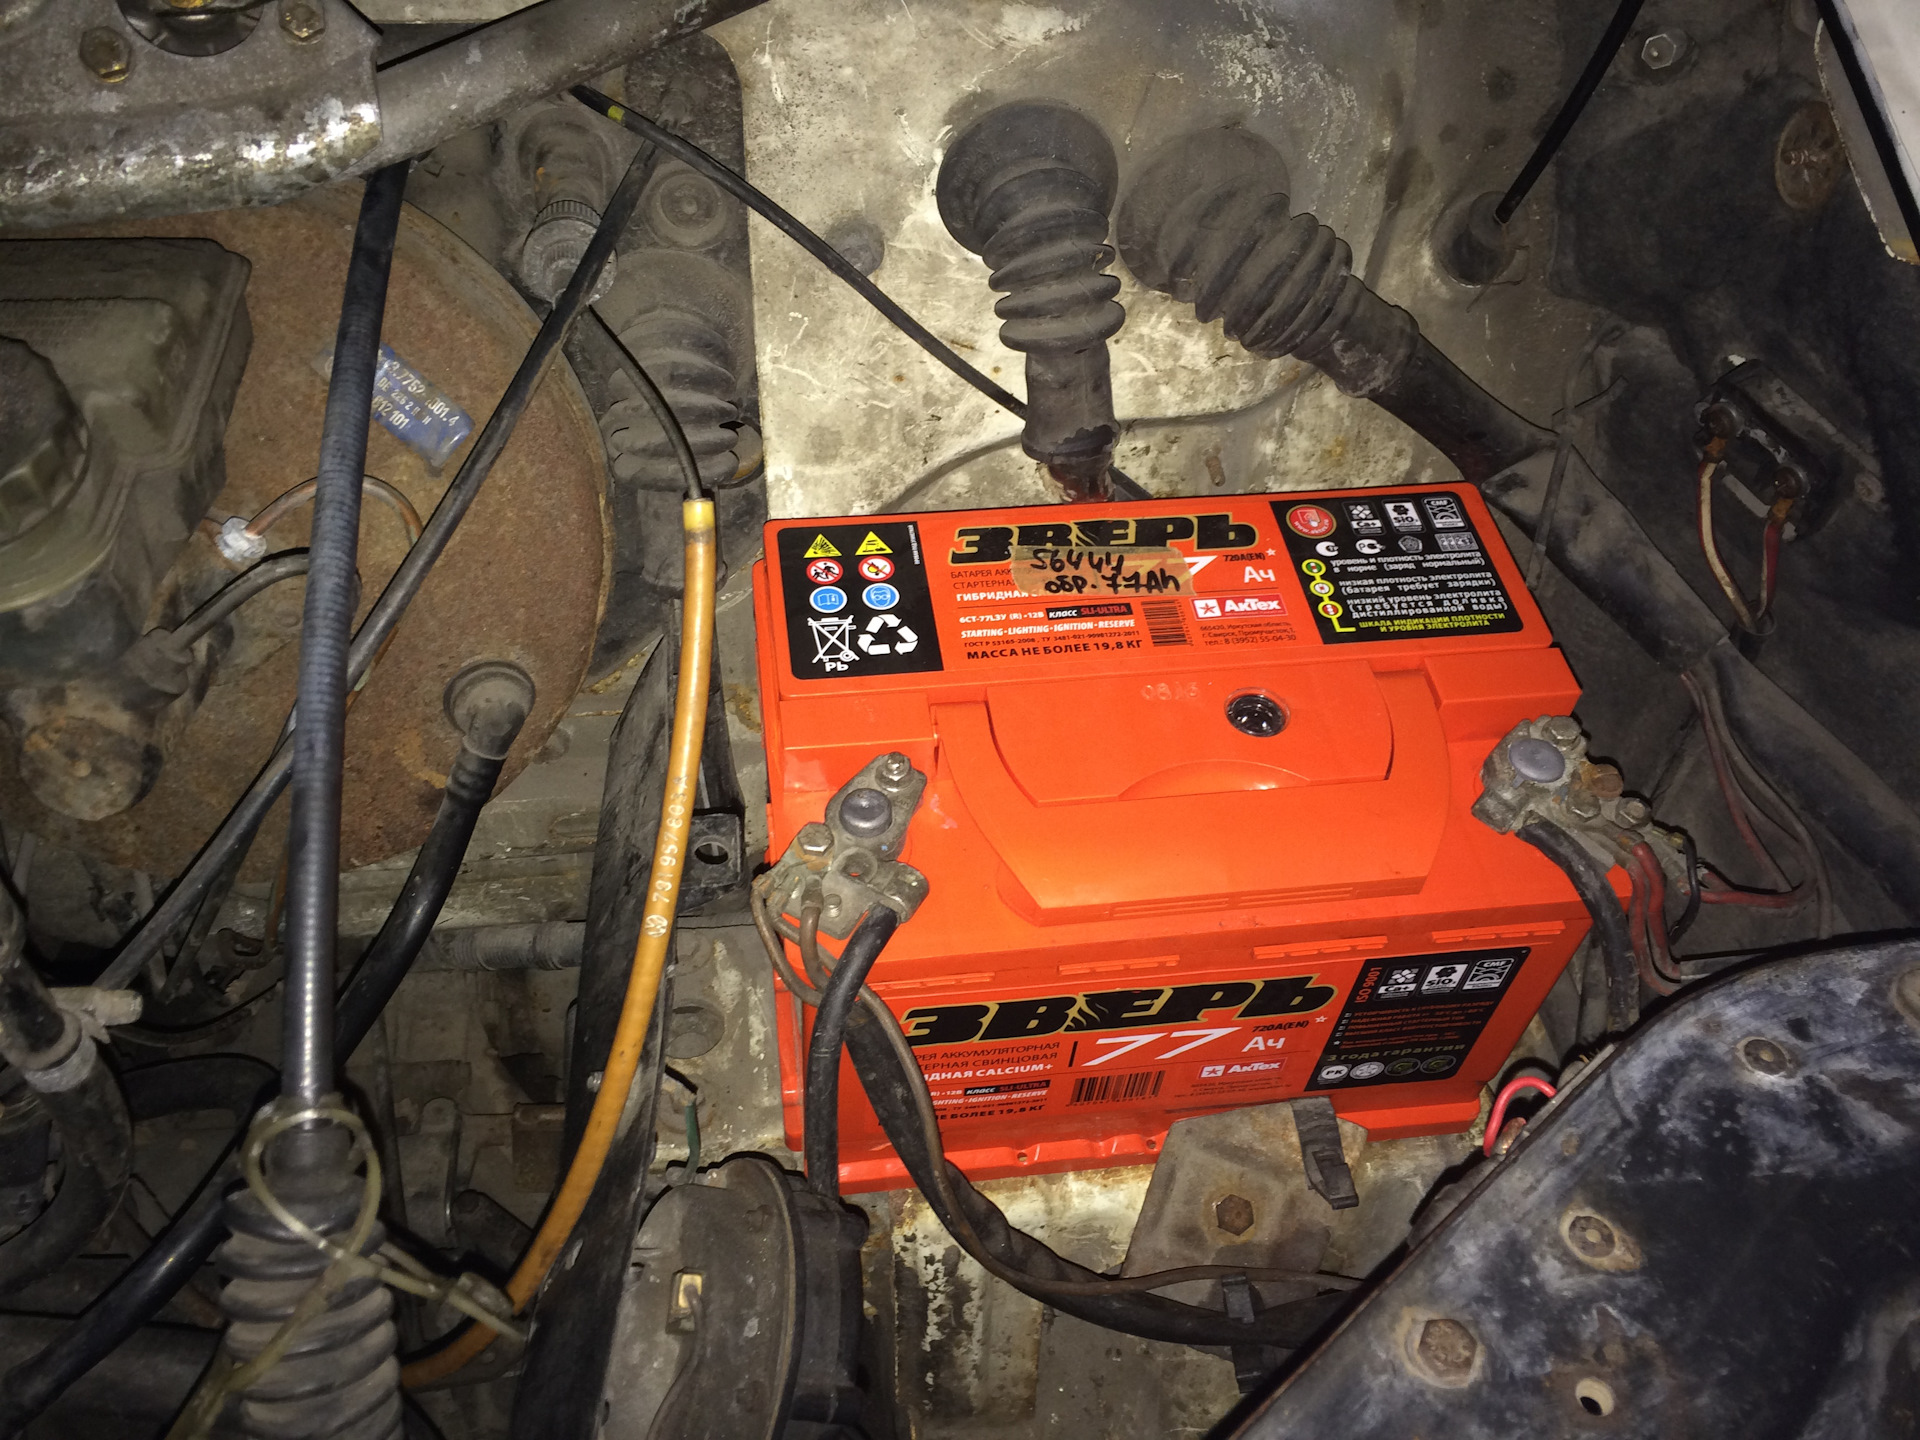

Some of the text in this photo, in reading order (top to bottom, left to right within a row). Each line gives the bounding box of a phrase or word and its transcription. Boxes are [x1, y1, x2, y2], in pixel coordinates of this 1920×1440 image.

[389, 410, 410, 429] 101
[1330, 559, 1368, 567] уровень
[1377, 555, 1424, 563] плотность
[1424, 551, 1481, 560] электролита
[1347, 565, 1377, 573] норме
[1422, 558, 1485, 568] нормальный)
[951, 568, 992, 579] БАТАРЕЯ
[1244, 566, 1276, 583] Ач
[1339, 572, 1492, 586] низкая плотность электролита
[1341, 578, 1496, 595] (батарея требует зарядки)
[1346, 590, 1501, 605] низкий уровень электролита
[1443, 596, 1505, 607] доливка
[1472, 601, 1508, 611] воды)
[1359, 613, 1506, 628] ШКАЛА ИНДИКАЦИИ ПЛОТНОСТИ
[1388, 624, 1425, 632] УРОВНЯ
[1426, 620, 1490, 630] ЭЛЕКТРОЛИТА
[967, 640, 1142, 659] МАССА НЕ БОЛЕЕ 19,8 КГ
[900, 973, 1338, 1048] ЗВЕРЬ
[940, 1042, 1060, 1060] АККУМУЛЯТОРНАЯ
[1081, 1027, 1243, 1067] 77
[1242, 1036, 1286, 1052] Ач
[1341, 1052, 1380, 1060] года
[1383, 1044, 1466, 1057] гарантии
[920, 1052, 1058, 1071] ТЕРНАЯ СВИНЦОВАЯ
[976, 1063, 1054, 1076] CALCIUM+
[950, 1110, 995, 1120] БОЛЕЕ
